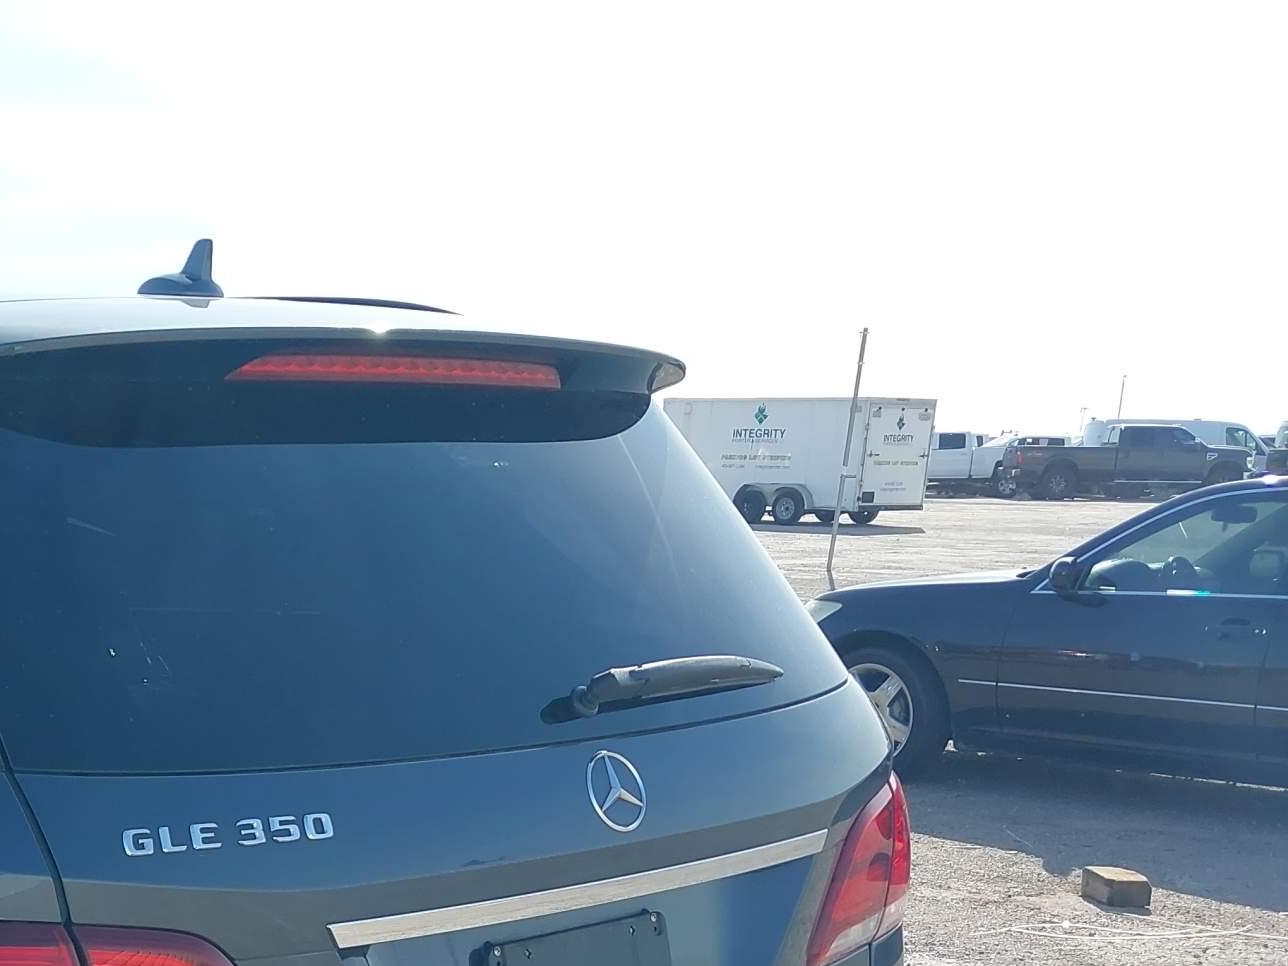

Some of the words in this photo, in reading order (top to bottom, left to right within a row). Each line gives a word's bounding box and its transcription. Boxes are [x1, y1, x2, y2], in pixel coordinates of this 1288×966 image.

[732, 428, 787, 439] INTEGRITY
[883, 434, 914, 443] INTEGRITY
[122, 822, 222, 857] GLE
[235, 812, 334, 846] 350
